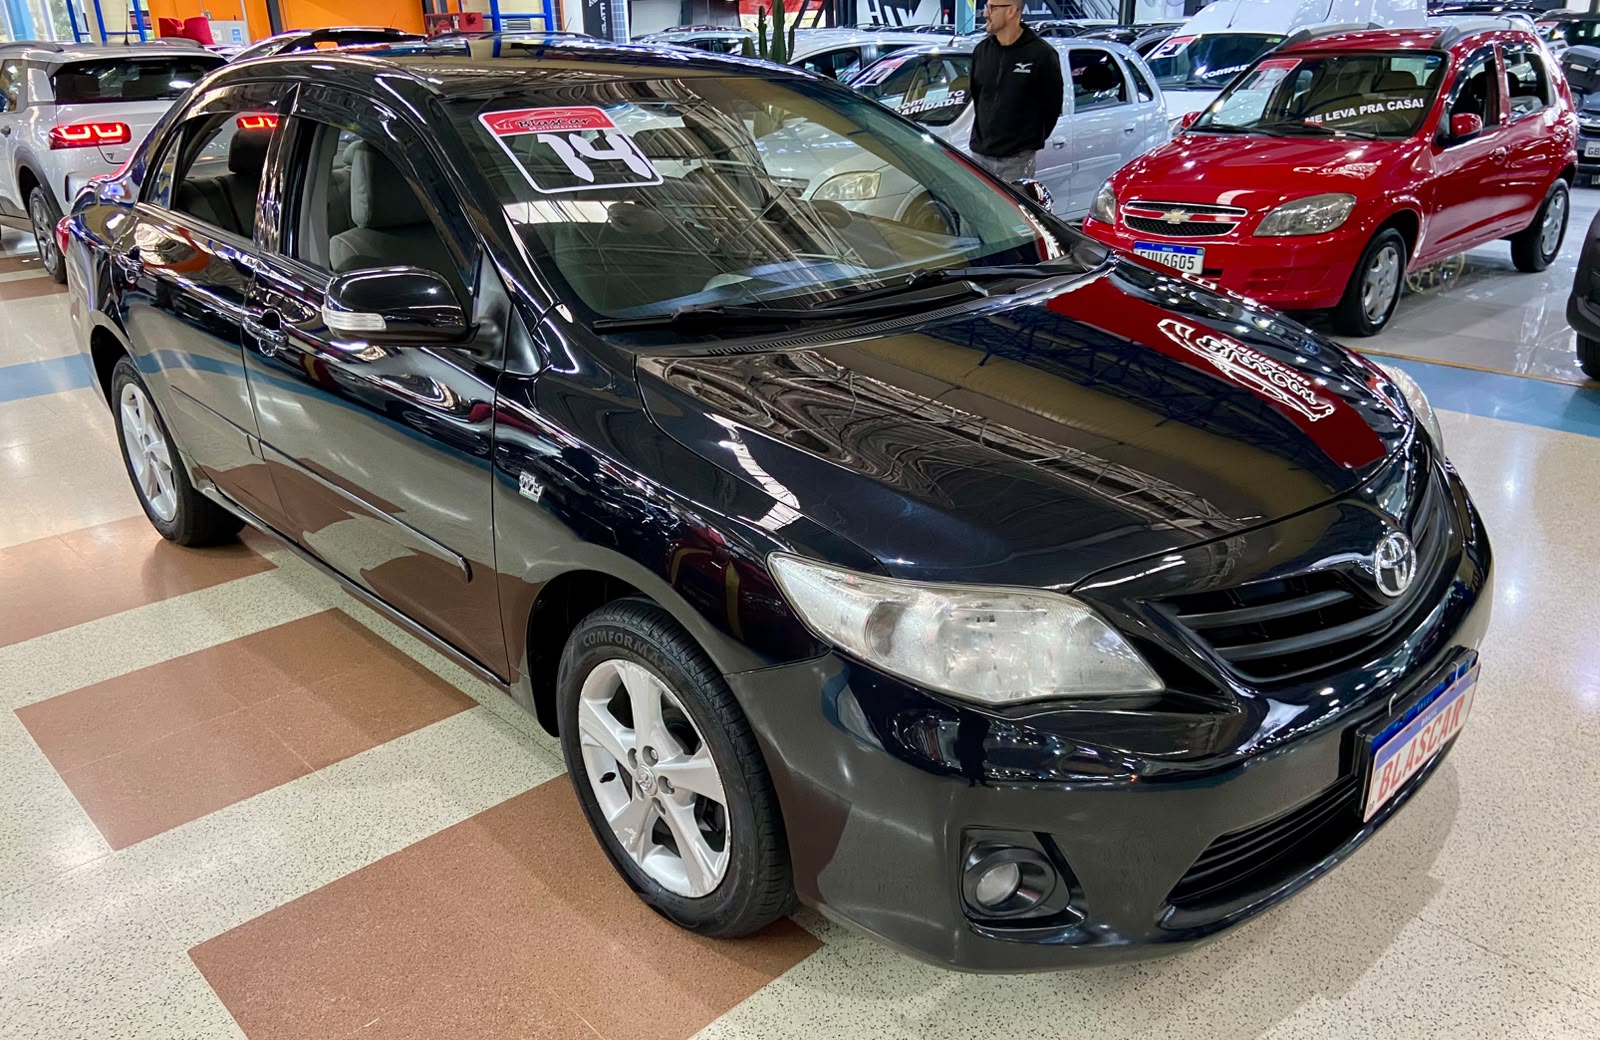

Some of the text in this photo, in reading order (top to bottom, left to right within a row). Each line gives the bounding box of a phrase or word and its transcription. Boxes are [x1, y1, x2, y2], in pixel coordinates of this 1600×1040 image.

[1325, 108, 1357, 121] LEVA
[1359, 103, 1385, 115] PRA
[1387, 98, 1424, 111] CASA!
[1377, 693, 1466, 801] BLASCAR
